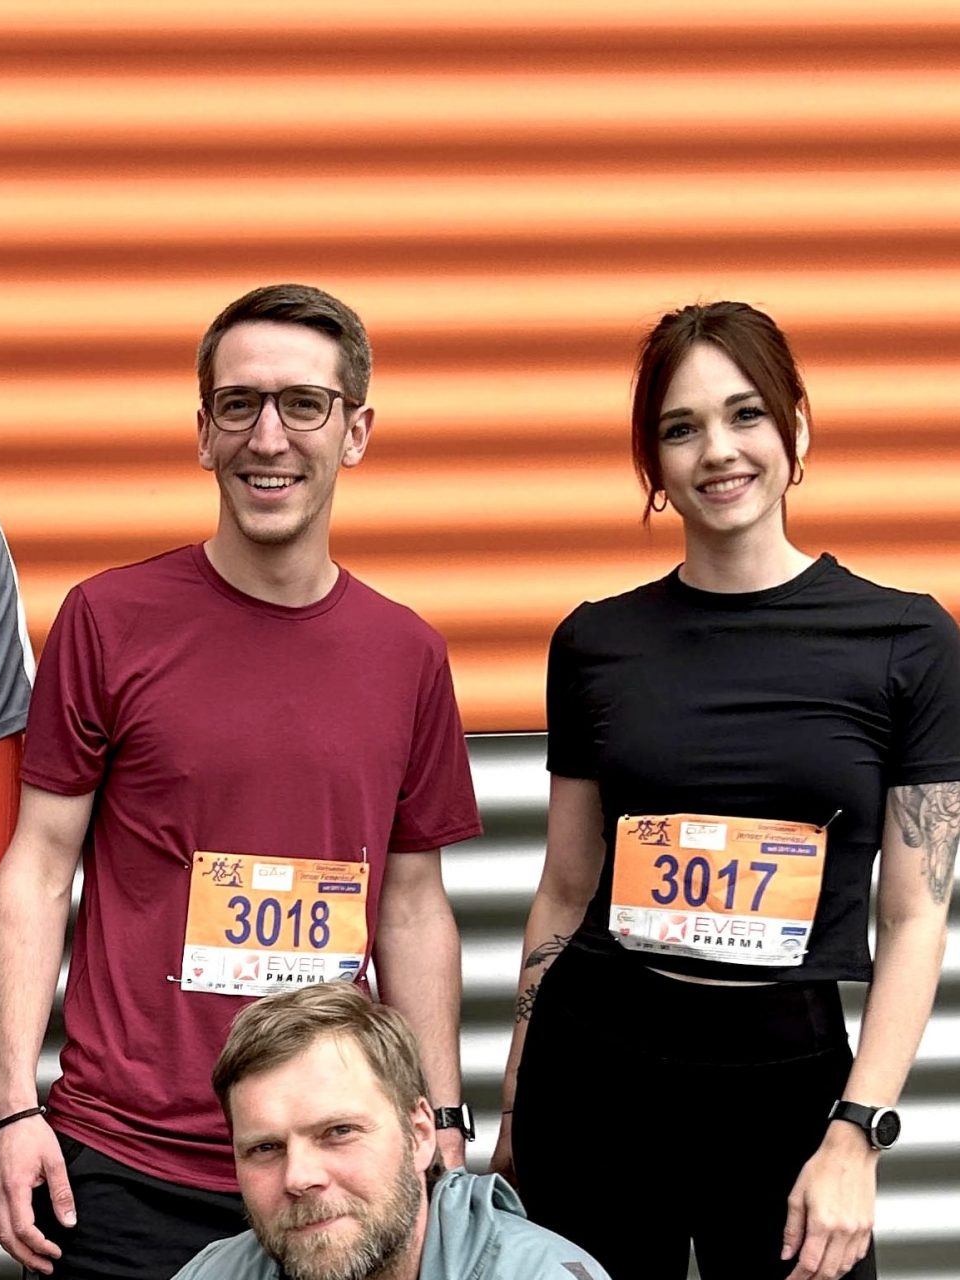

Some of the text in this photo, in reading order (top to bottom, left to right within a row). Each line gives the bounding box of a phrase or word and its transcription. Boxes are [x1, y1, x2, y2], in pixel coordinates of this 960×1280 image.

[651, 854, 778, 911] 3017
[224, 895, 330, 949] 3018
[693, 916, 766, 937] EVER
[693, 934, 763, 950] PHARMA
[267, 956, 326, 973] EVER
[266, 973, 325, 983] PHARMA
